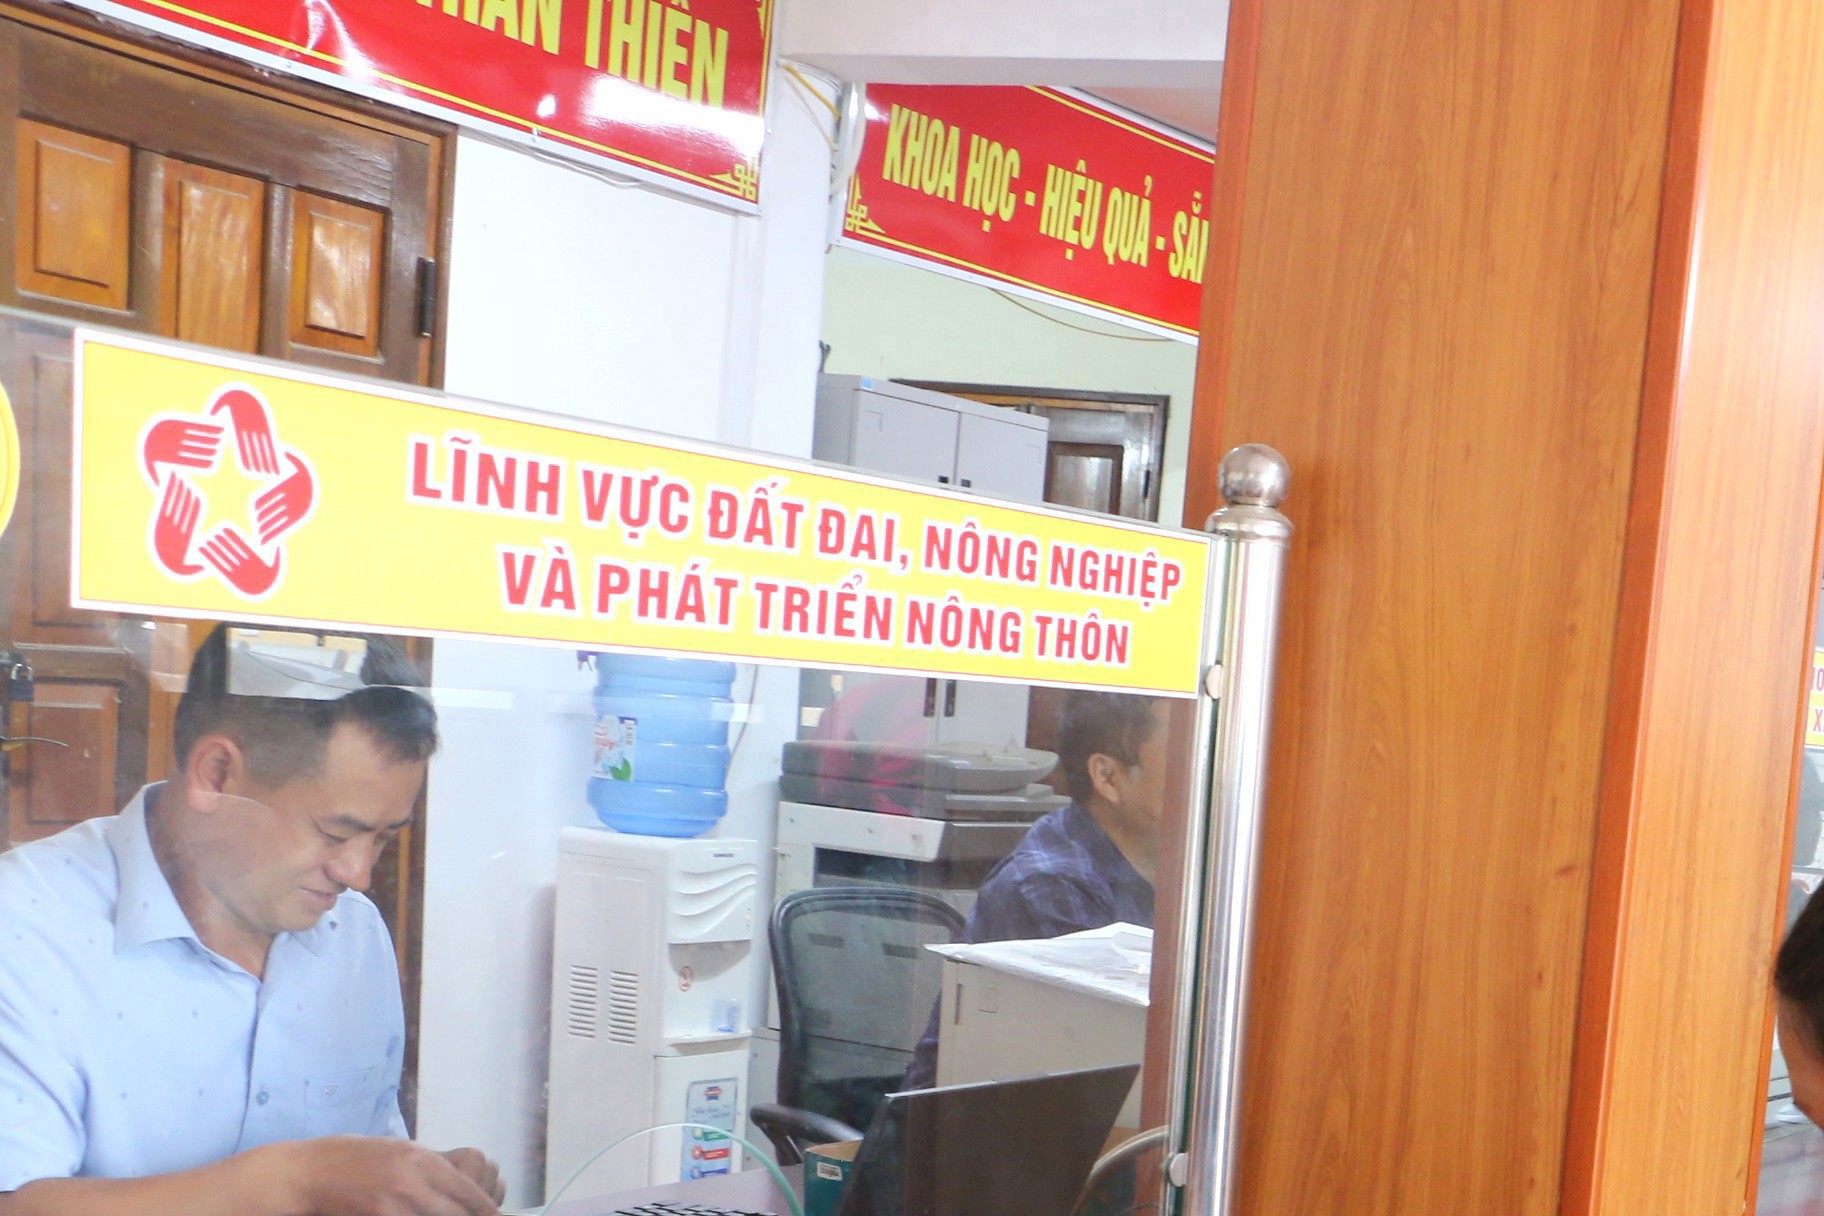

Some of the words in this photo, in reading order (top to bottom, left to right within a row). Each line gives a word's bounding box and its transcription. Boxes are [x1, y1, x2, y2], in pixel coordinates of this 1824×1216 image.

[882, 103, 961, 203] KHOA
[962, 133, 1020, 233] HỌC
[1039, 159, 1103, 261] HIỆU
[1103, 175, 1153, 268] QUẢ
[412, 436, 561, 516] LĨNH
[582, 469, 690, 540] VỰC
[708, 482, 804, 549] ĐẤT
[818, 508, 908, 570] ĐAI,
[925, 521, 1037, 583] NÔNG
[1050, 545, 1181, 608] NGHIỆP
[503, 546, 577, 611] VÀ
[597, 563, 738, 626] PHÁT
[755, 574, 892, 641] TRIỂN
[907, 595, 1021, 654] NÔNG
[1036, 612, 1129, 664] THÔN
